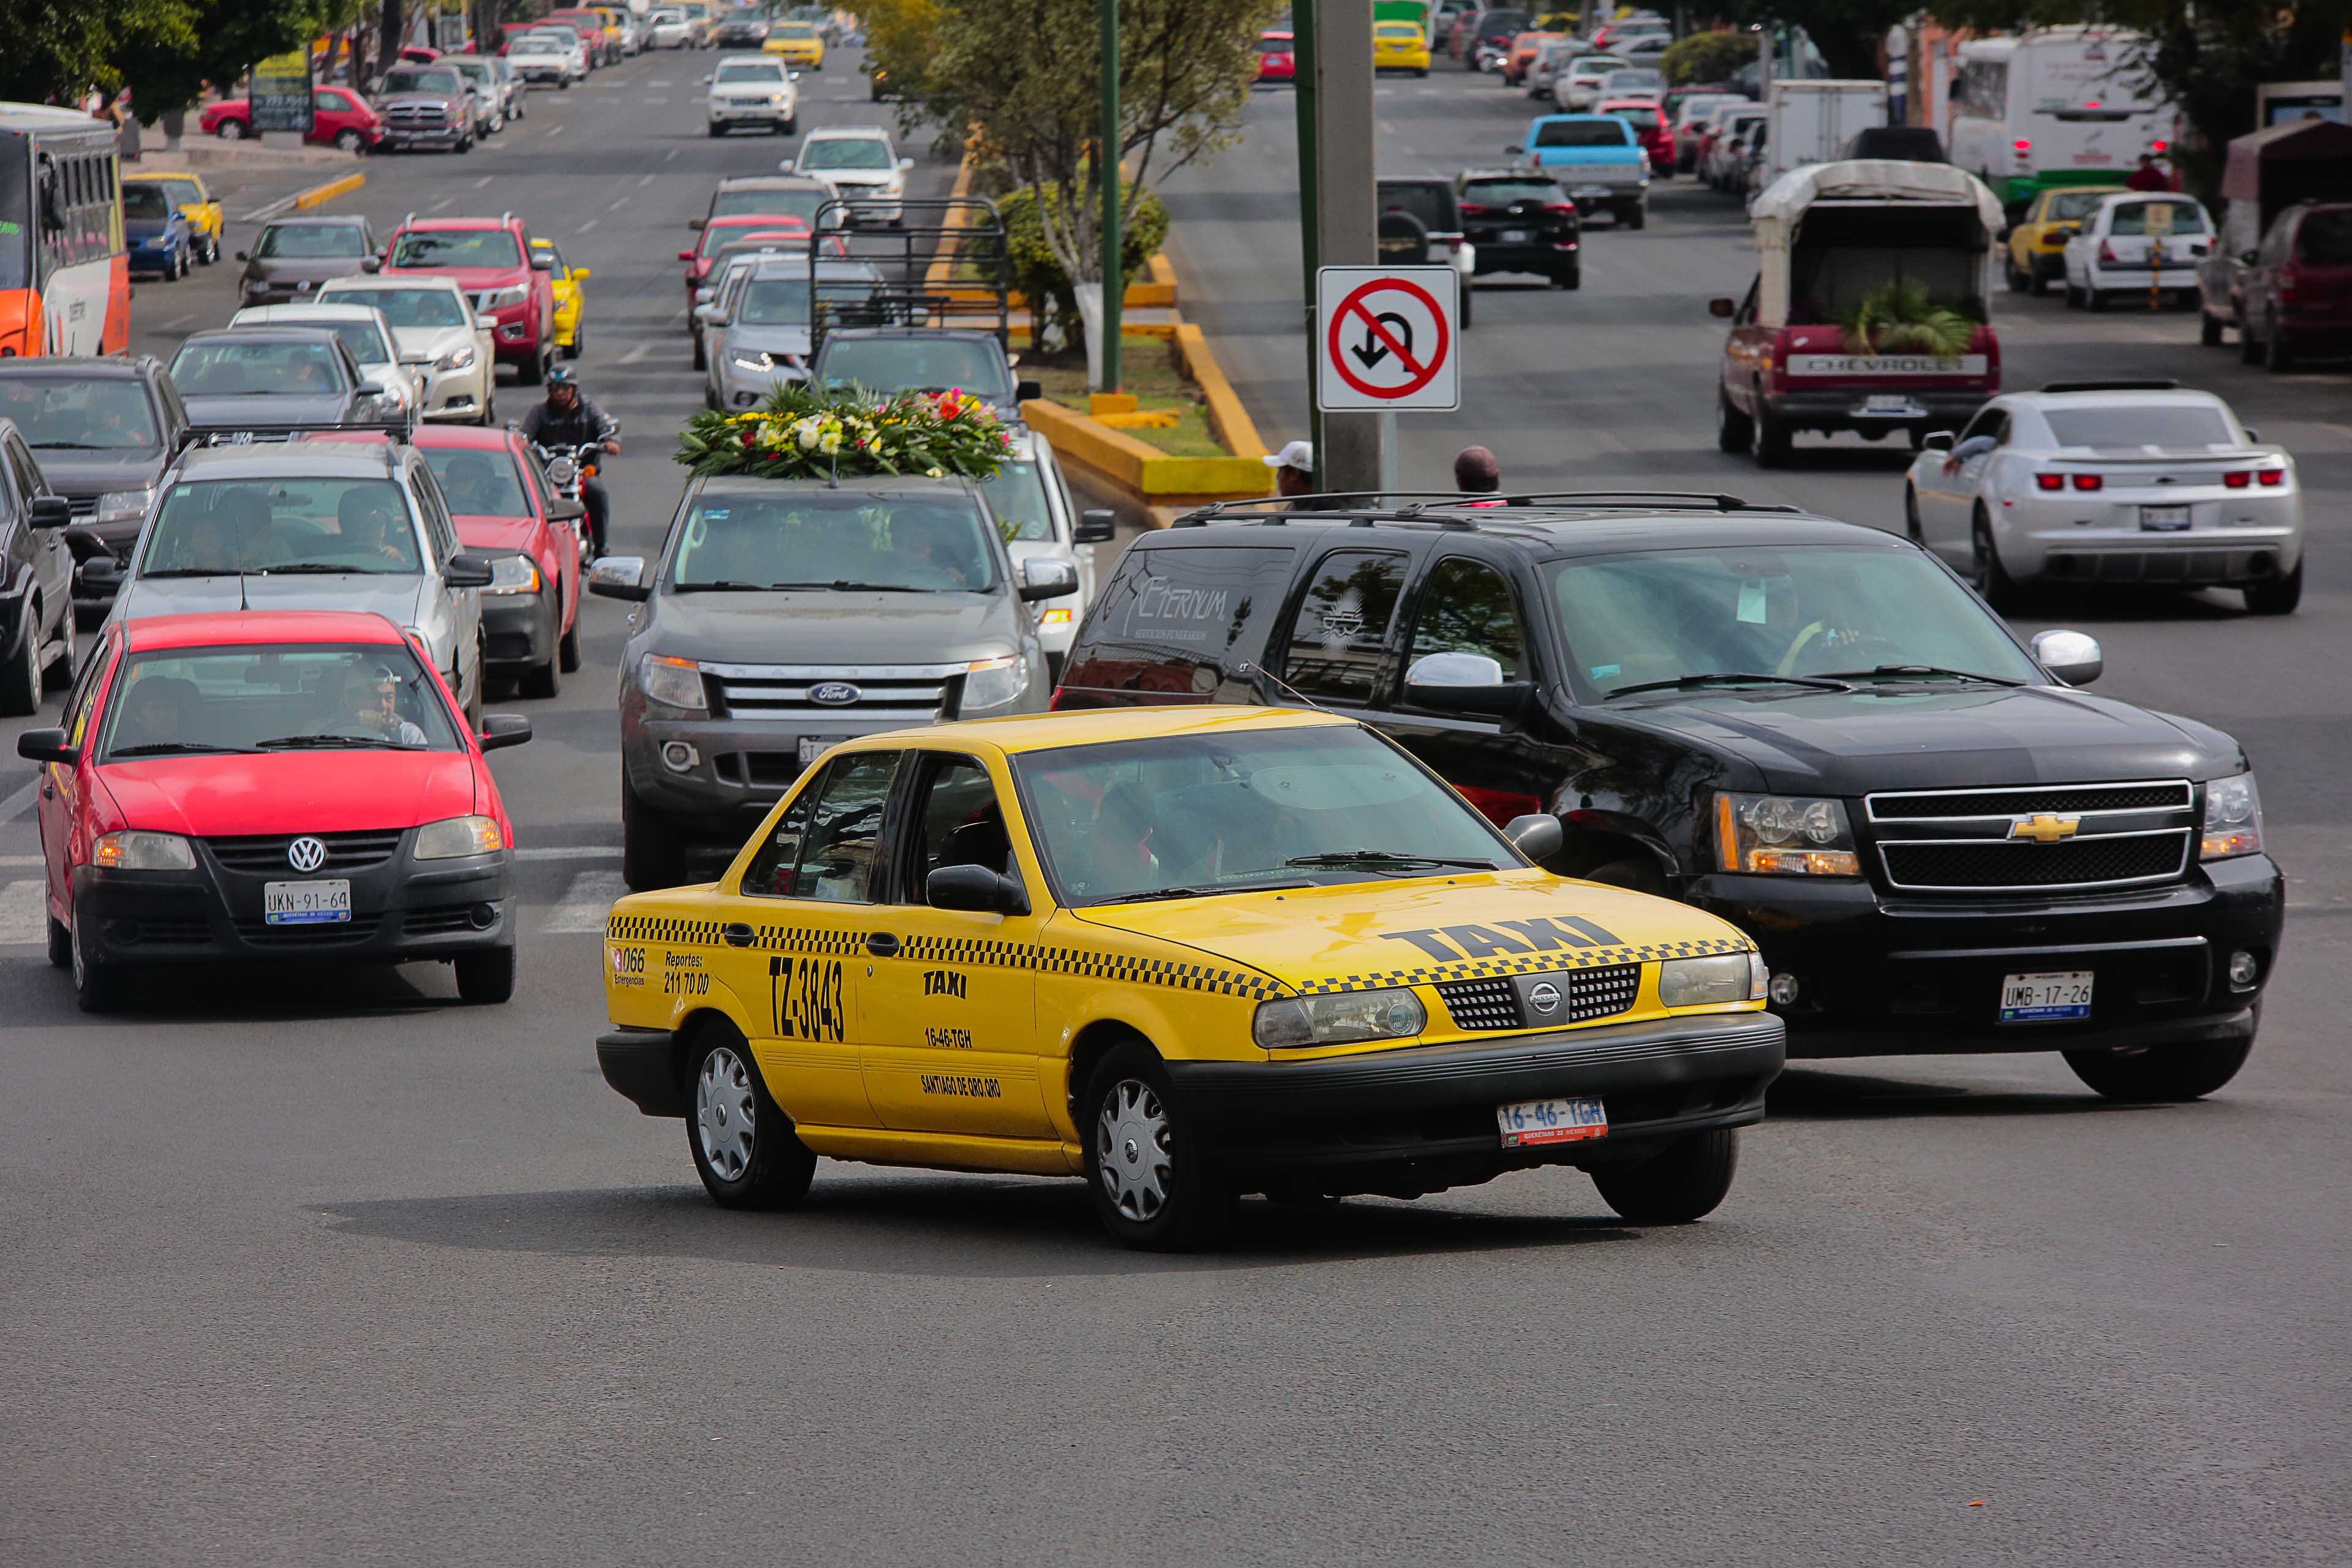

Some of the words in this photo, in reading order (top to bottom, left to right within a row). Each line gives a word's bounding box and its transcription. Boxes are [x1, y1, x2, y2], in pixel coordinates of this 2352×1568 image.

[818, 685, 850, 699] Ford
[268, 892, 347, 911] UKN-91-64
[1377, 916, 1625, 962] TAXI
[623, 947, 646, 973] 066
[665, 951, 703, 970] Reportes:
[664, 971, 680, 993] 211
[684, 972, 695, 995] 70
[696, 973, 709, 995] 00
[923, 970, 967, 1000] TAXI
[769, 956, 844, 1042] TZ-3843
[2006, 985, 2089, 1006] UMB-17-26
[925, 1027, 973, 1049] 16-46-TGH
[921, 1074, 957, 1095] SANTIAGO
[956, 1076, 969, 1096] DE
[1502, 1098, 1604, 1130] 16-46-TGH
